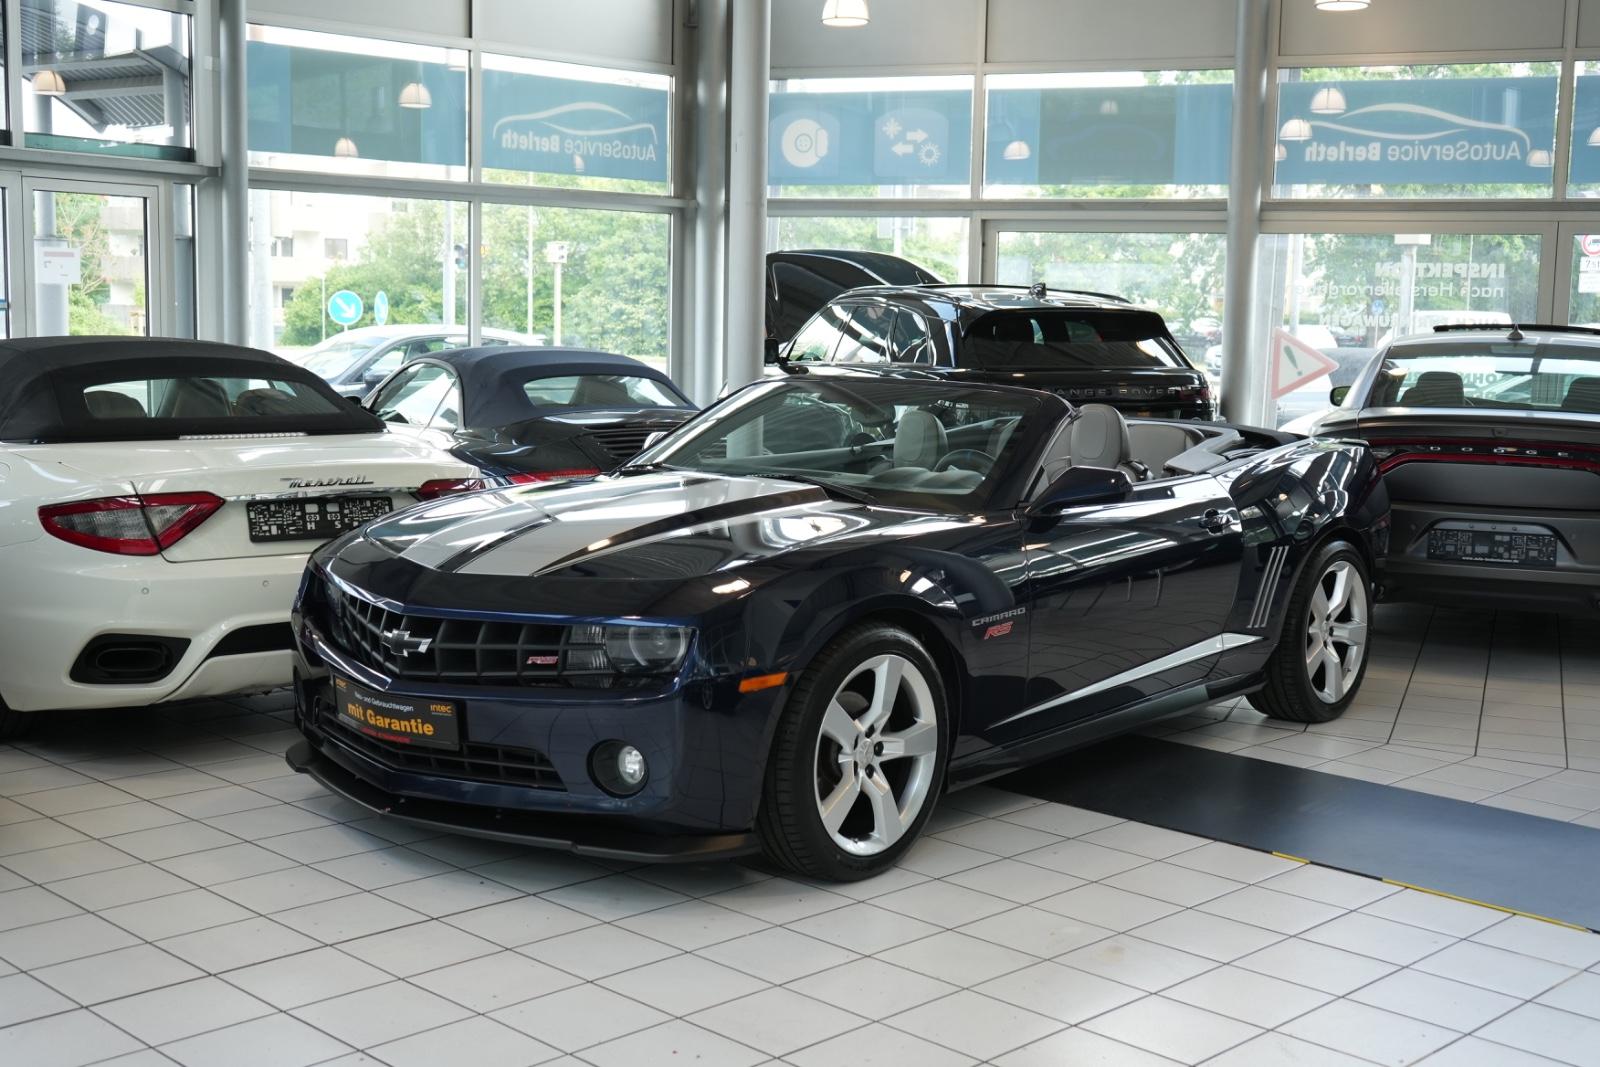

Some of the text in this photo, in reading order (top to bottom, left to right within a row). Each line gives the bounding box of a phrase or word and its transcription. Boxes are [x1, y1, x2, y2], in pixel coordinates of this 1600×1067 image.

[1055, 387, 1176, 396] ANGE ROVER
[1429, 445, 1570, 457] DODGE
[280, 475, 375, 489] Maserati
[971, 606, 1026, 627] CAMARO
[984, 621, 1014, 640] RS
[347, 702, 365, 721] mit
[366, 708, 435, 736] Garantie
